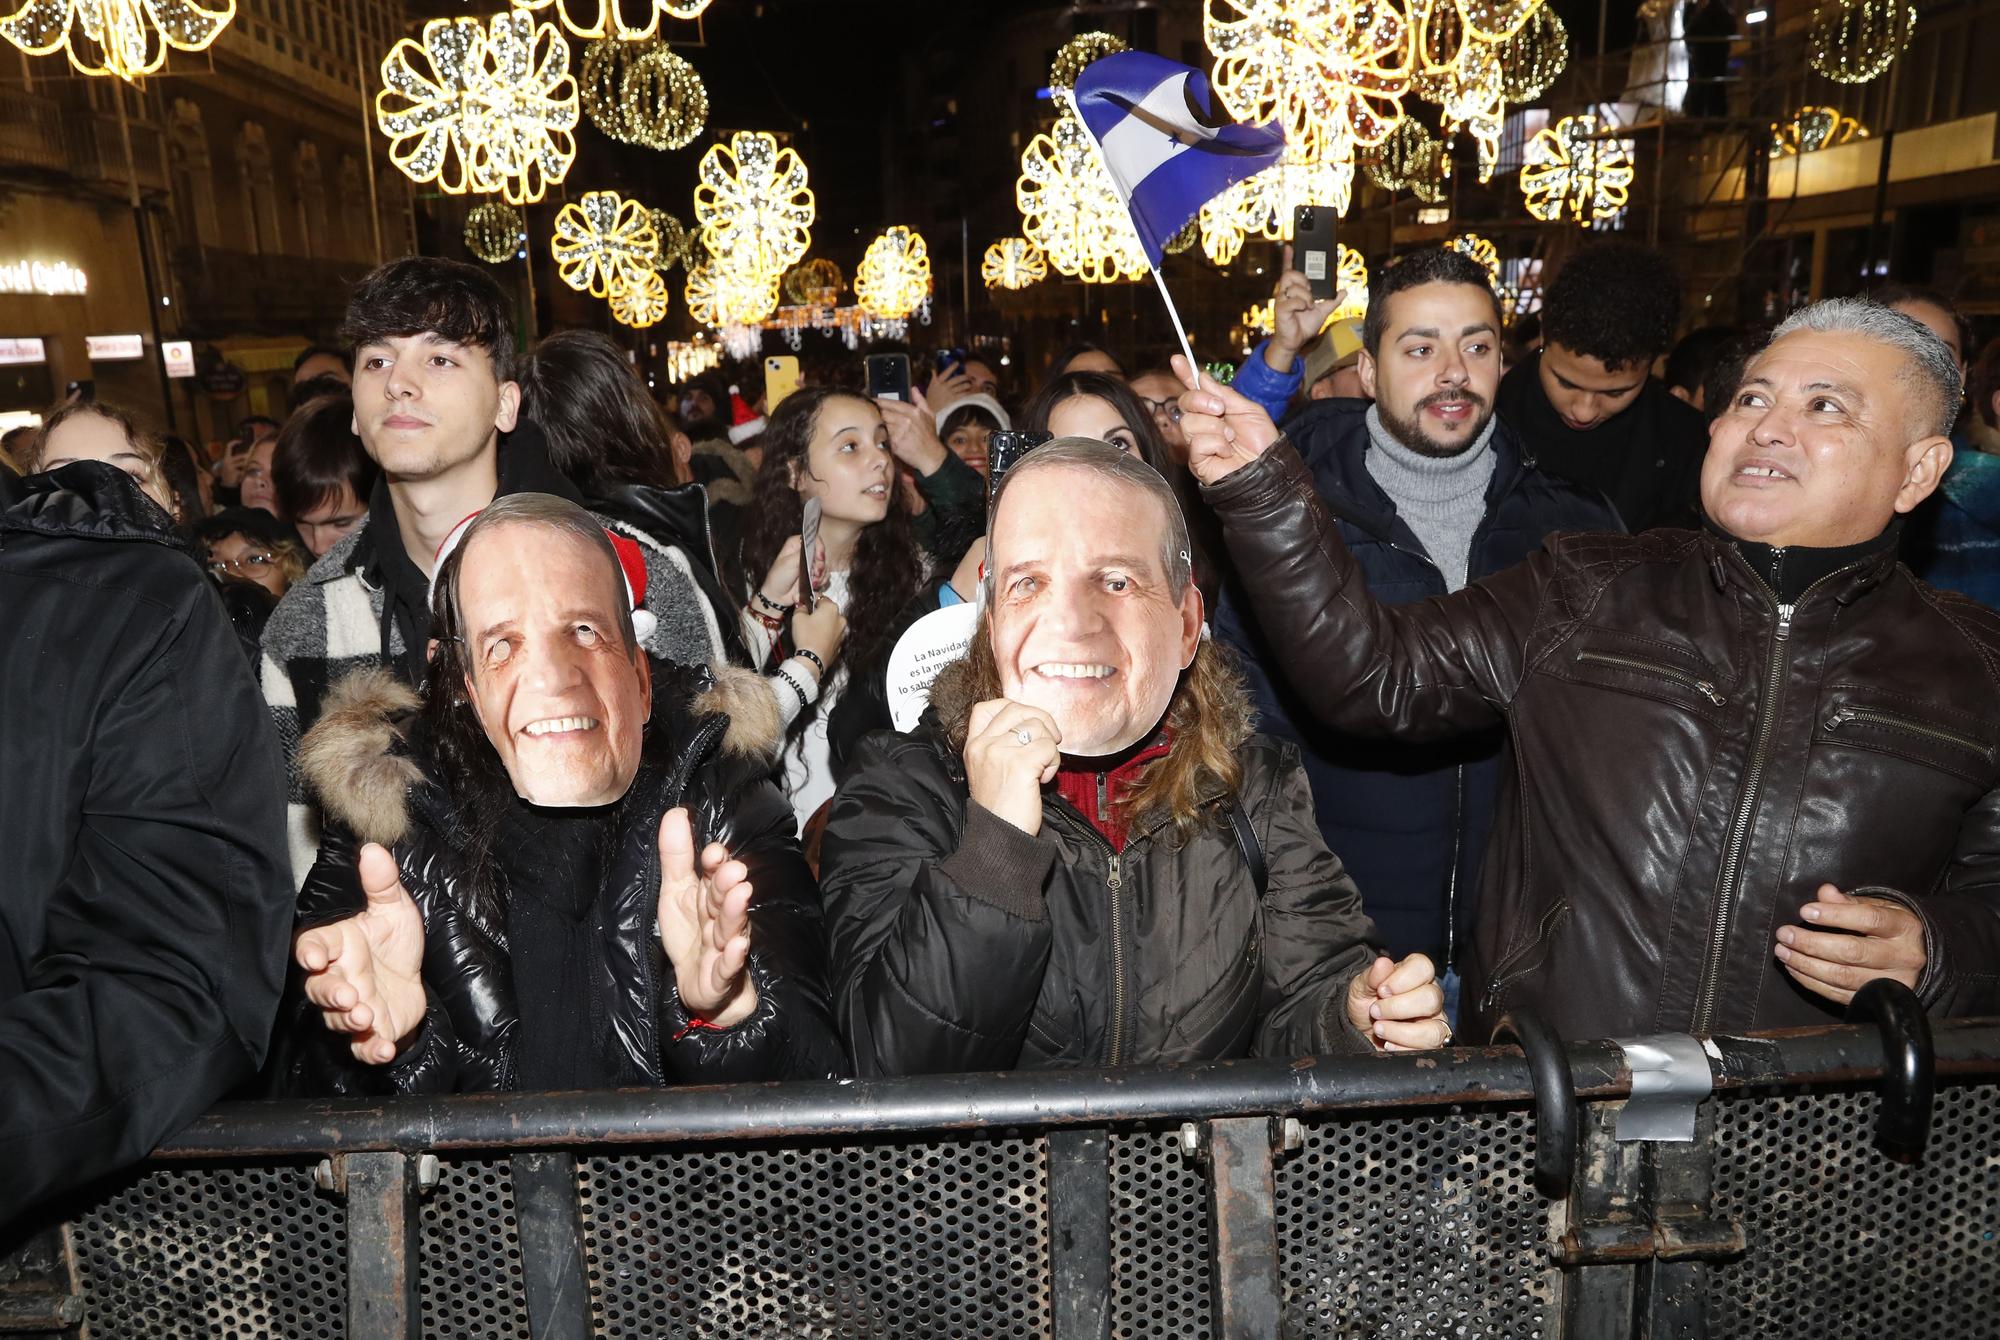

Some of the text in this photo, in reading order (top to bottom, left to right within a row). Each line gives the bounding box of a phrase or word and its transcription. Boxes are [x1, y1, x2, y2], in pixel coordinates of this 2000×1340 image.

[914, 638, 968, 662] La Navidad
[910, 669, 920, 678] es
[921, 665, 931, 674] la
[898, 686, 908, 695] lo
